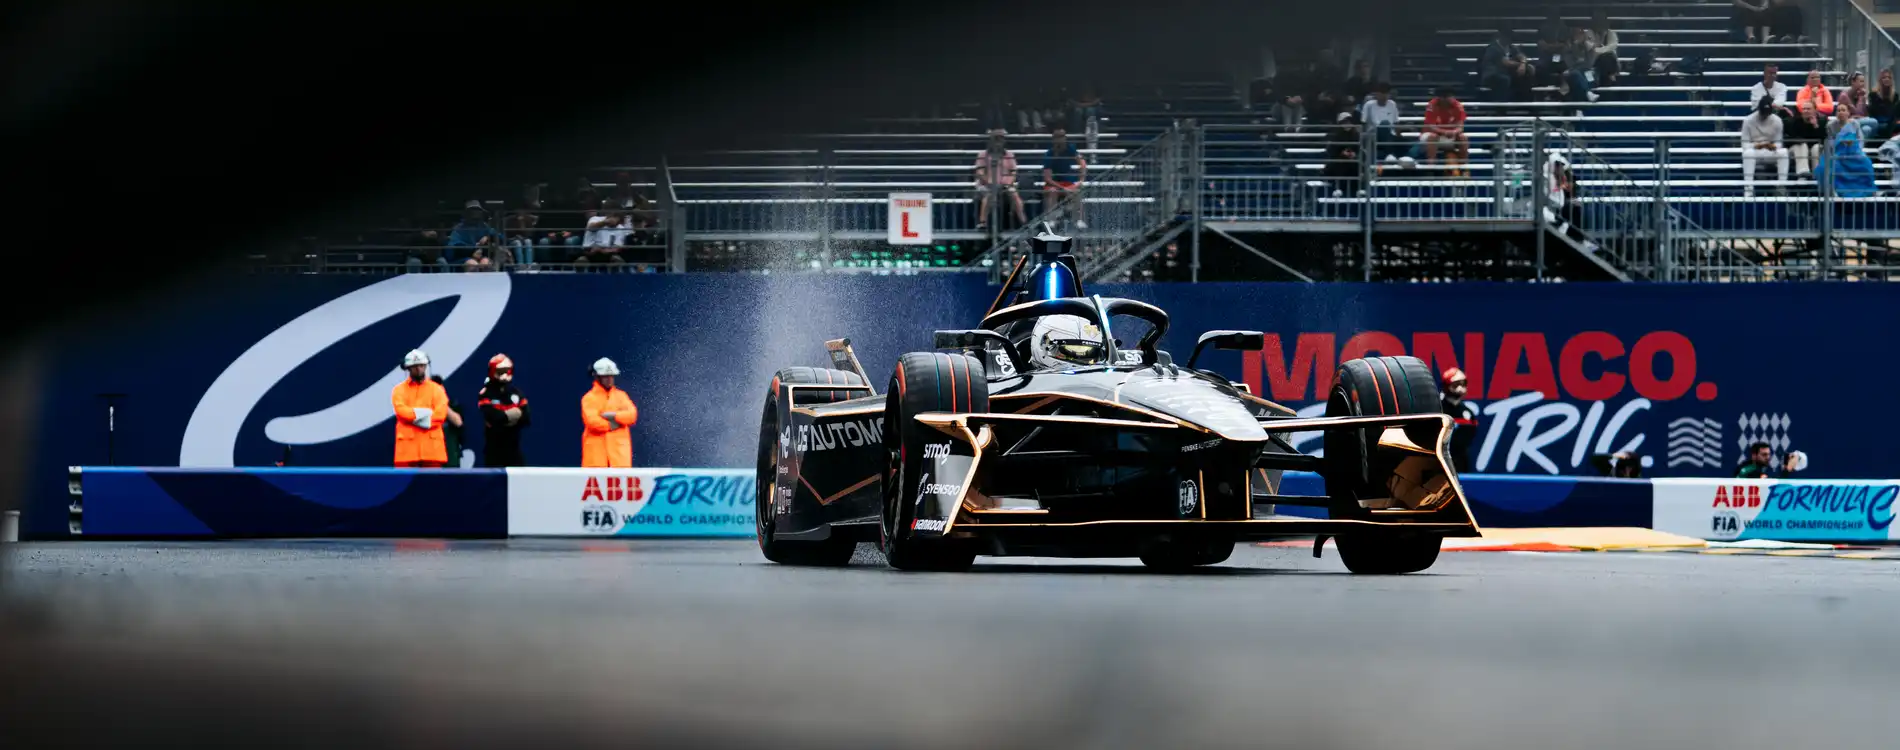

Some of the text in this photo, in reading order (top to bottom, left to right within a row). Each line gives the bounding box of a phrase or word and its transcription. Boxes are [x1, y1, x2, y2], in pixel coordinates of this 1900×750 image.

[902, 211, 919, 237] L
[581, 475, 644, 502] ABB
[925, 483, 961, 496] SYENSQO
[1712, 485, 1761, 508] ABB
[1763, 484, 1868, 514] FORMULA
[622, 513, 674, 525] WORLD
[1743, 519, 1782, 529] WORLD
[1786, 519, 1864, 530] CHAMPIONSHIP
